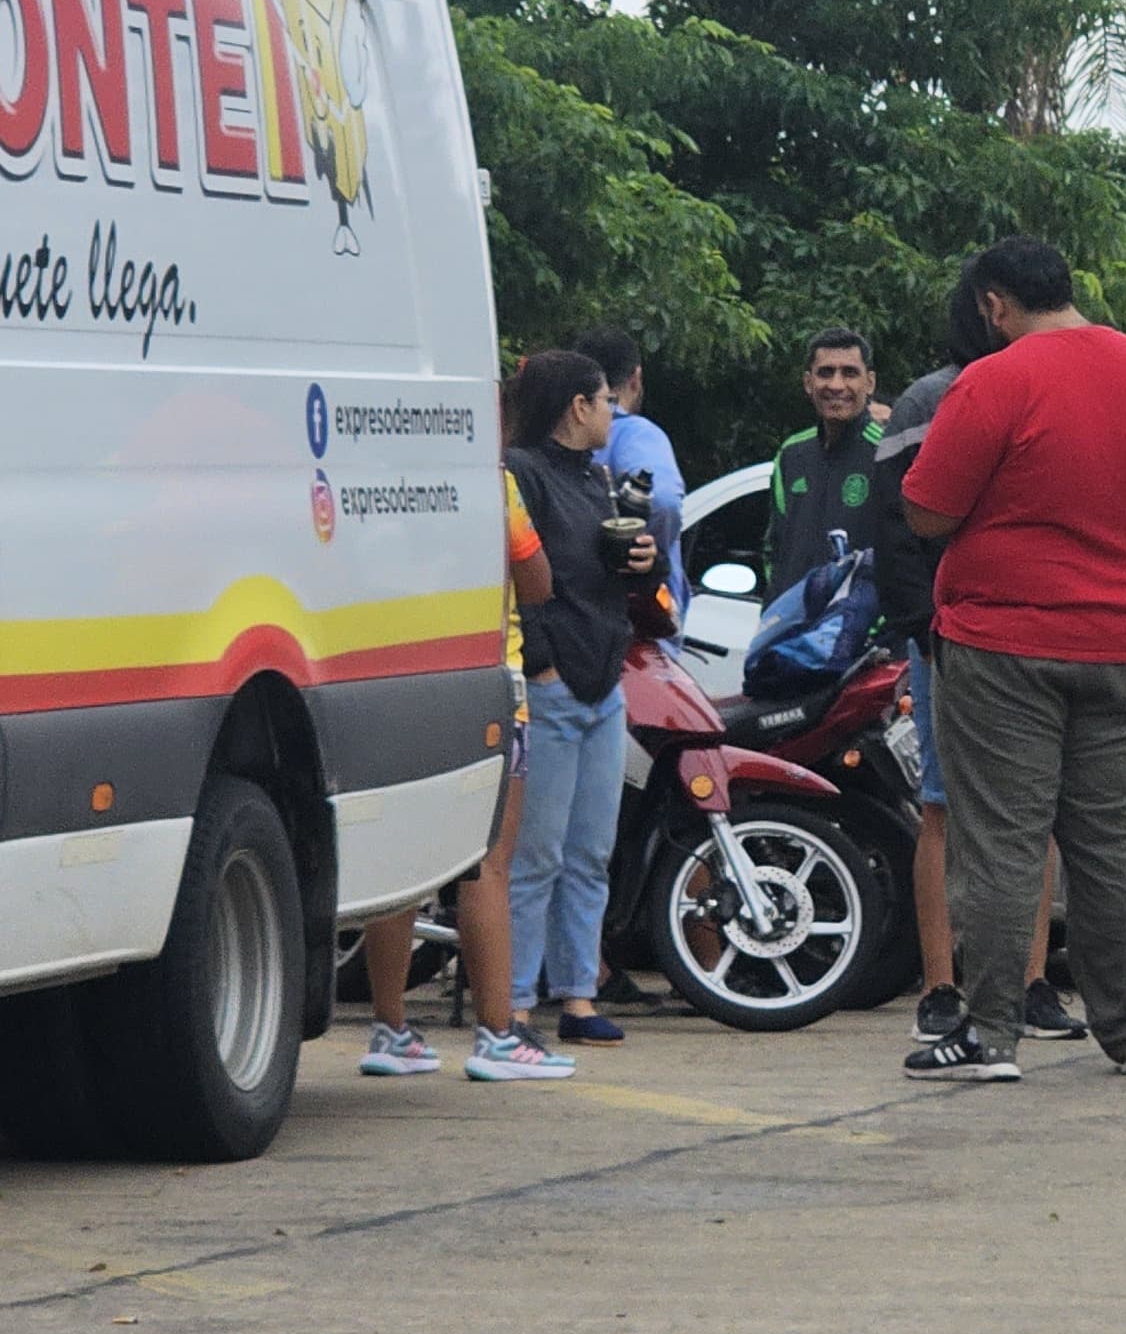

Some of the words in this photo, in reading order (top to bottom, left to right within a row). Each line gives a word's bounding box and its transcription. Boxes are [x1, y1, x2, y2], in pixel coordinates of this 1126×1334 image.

[88, 219, 196, 360] llega.
[335, 398, 474, 442] expresodemontearg
[340, 478, 459, 522] expresodemonte
